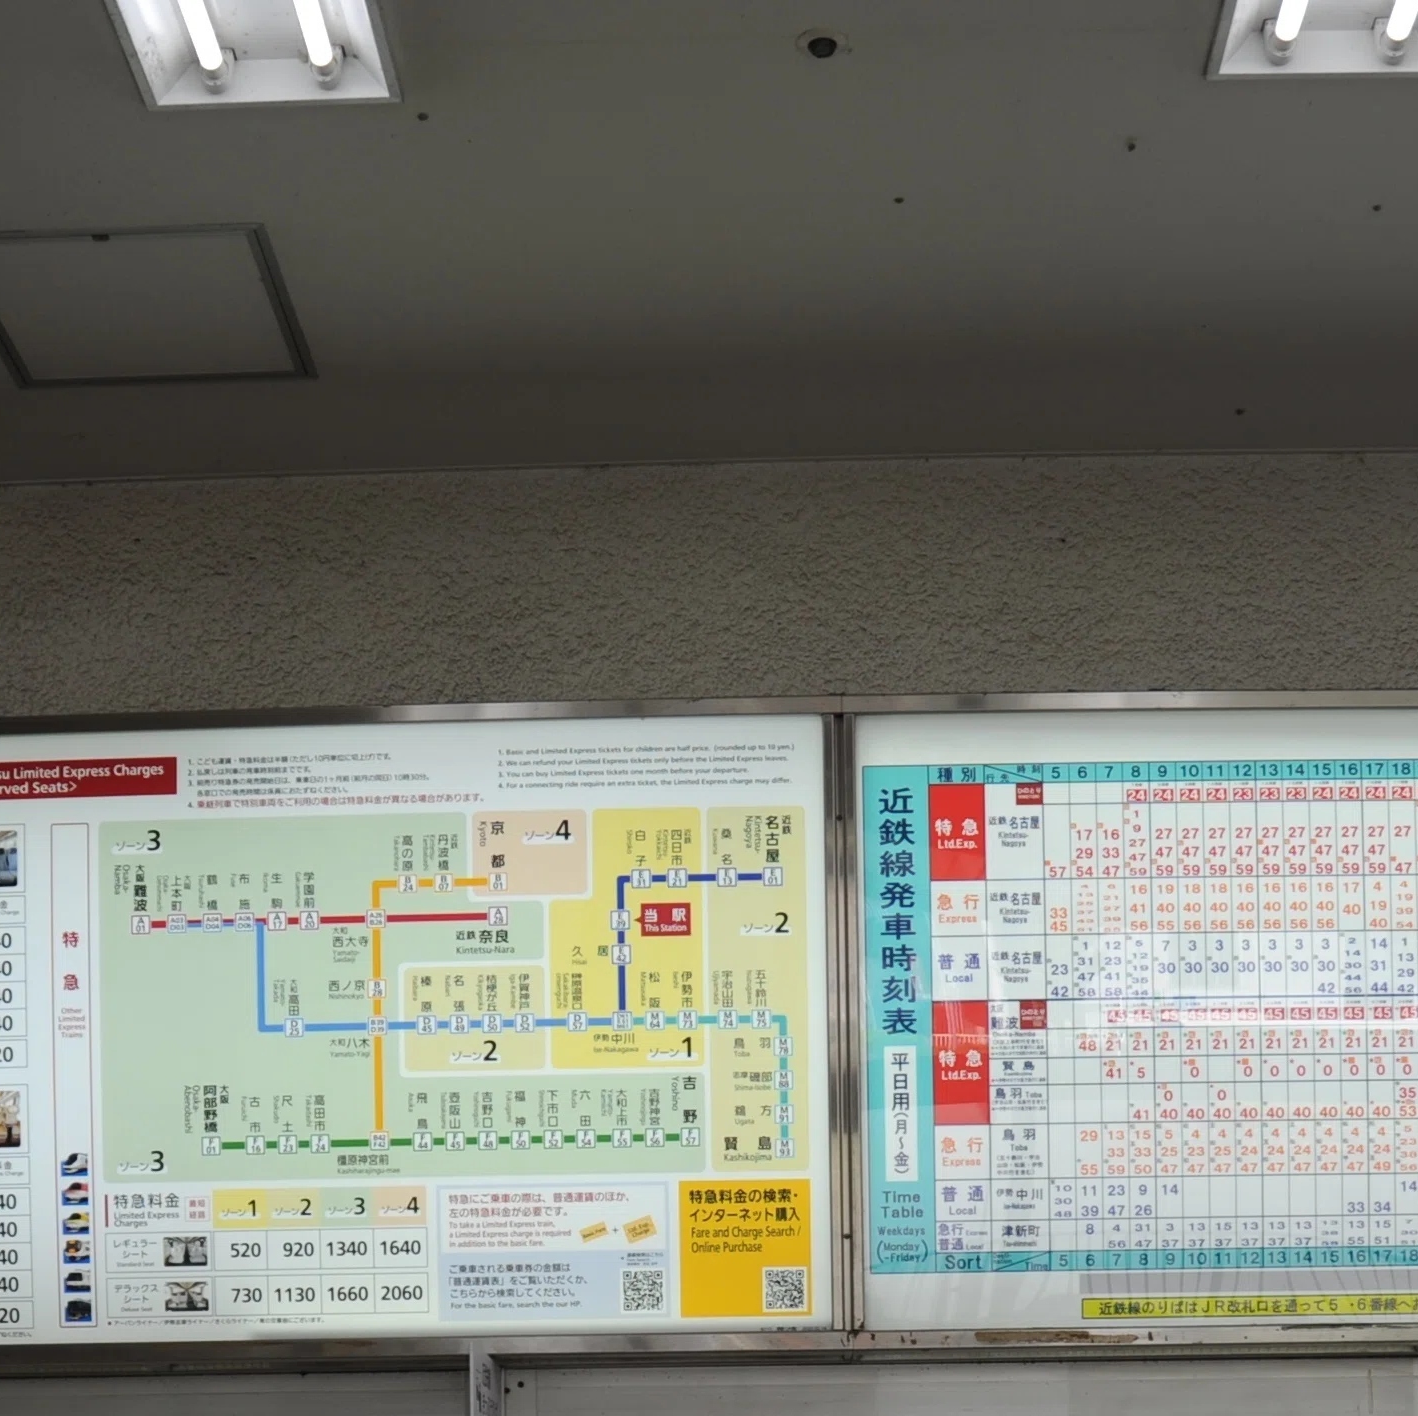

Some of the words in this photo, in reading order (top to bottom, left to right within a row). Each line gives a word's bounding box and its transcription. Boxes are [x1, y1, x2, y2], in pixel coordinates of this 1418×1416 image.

[12, 767, 59, 780] Limited
[63, 765, 110, 782] Express
[113, 763, 164, 780] Charges
[935, 818, 979, 836] 特急
[988, 815, 1041, 830] 近鉄名古屋
[490, 821, 505, 868] 京都
[936, 893, 980, 910] 急行
[644, 908, 687, 923] 当駅
[878, 787, 918, 1035] 近鉄線発車時刻表
[938, 913, 978, 926] Express
[644, 923, 660, 933] This
[662, 922, 687, 933] Station
[456, 929, 509, 944] 近鉄奈良
[937, 953, 981, 970] 普通
[945, 973, 973, 984] Local
[683, 1077, 698, 1124] 吉野
[724, 1136, 772, 1151] 賢島
[724, 1153, 772, 1163] Kashikojima
[114, 1193, 180, 1209] 特急料金
[882, 1191, 921, 1204] Time
[114, 1211, 145, 1220] Limited
[147, 1210, 180, 1221] Express
[689, 1206, 800, 1222] インターネット購入
[881, 1206, 924, 1219] Table
[114, 1219, 148, 1229] Charges
[877, 1225, 925, 1238] Weekdays
[691, 1226, 710, 1237] Fare
[713, 1226, 730, 1237] and
[731, 1225, 763, 1239] Charge
[766, 1225, 795, 1237] Search
[230, 1243, 261, 1258] 520
[283, 1243, 314, 1257] 920
[326, 1241, 367, 1256] 1340
[380, 1240, 421, 1255] 1640
[691, 1241, 720, 1253] Online
[723, 1240, 763, 1253] Purchase
[944, 1254, 983, 1271] Sort
[232, 1288, 262, 1303] 730
[274, 1287, 315, 1302] 1130
[327, 1286, 368, 1301] 1660
[381, 1285, 423, 1300] 2060
